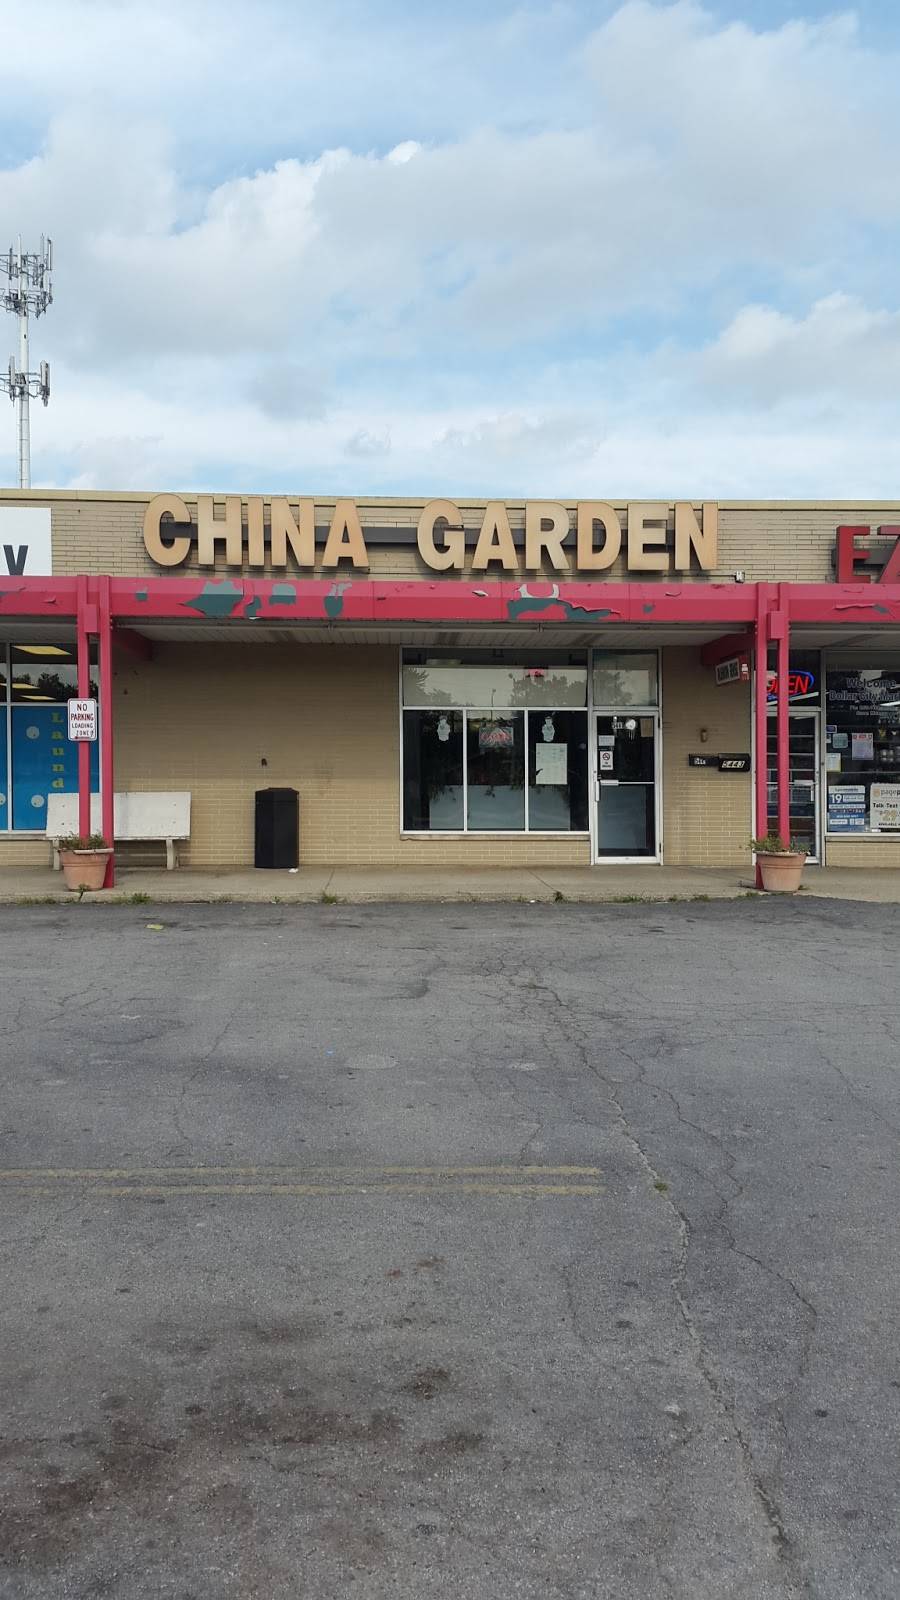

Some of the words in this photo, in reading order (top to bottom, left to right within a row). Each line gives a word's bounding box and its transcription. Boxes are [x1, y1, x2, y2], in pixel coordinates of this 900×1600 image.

[143, 493, 369, 566] CHINA
[417, 499, 718, 571] GARDEN
[847, 678, 896, 689] Welcome
[829, 690, 858, 701] Dollar
[76, 703, 88, 711] NO
[70, 713, 94, 721] PARKING
[831, 794, 843, 804] 19
